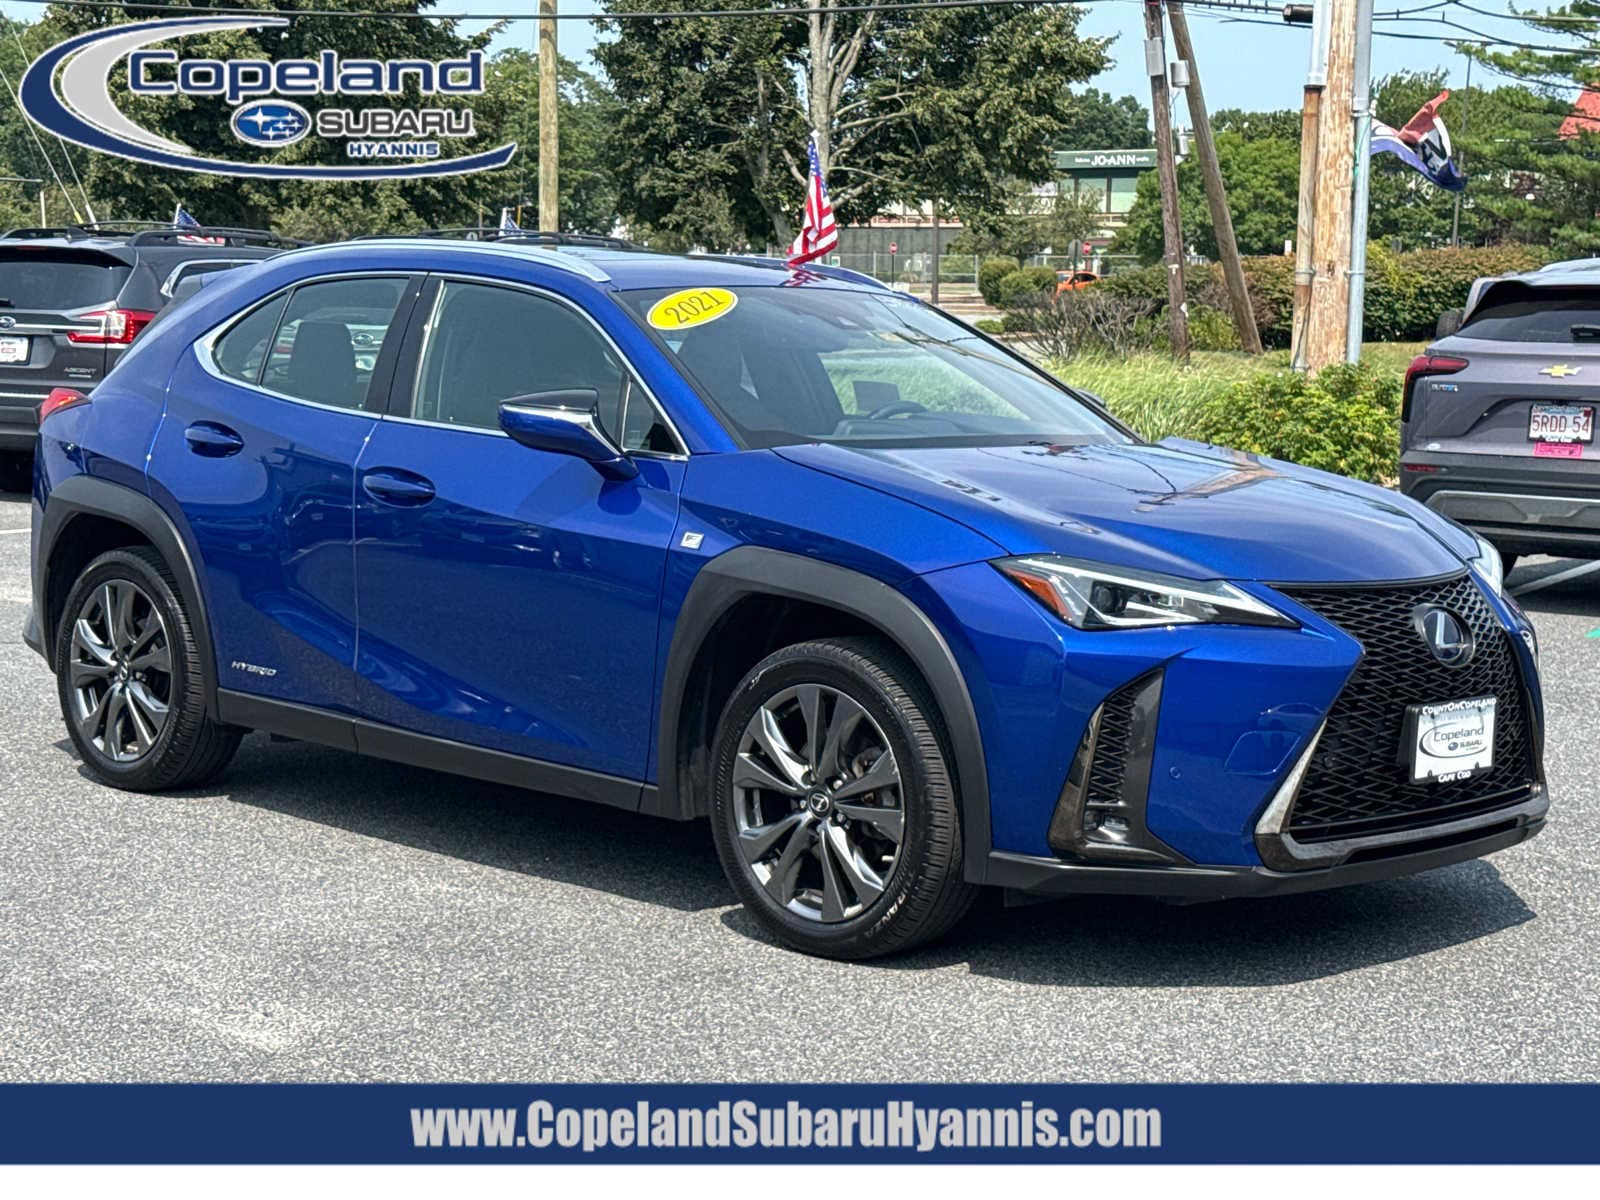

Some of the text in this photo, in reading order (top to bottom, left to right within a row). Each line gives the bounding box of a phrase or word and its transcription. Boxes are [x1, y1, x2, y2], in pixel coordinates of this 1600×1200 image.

[664, 291, 726, 324] 2021
[231, 660, 278, 677] HYBRID
[1434, 728, 1484, 742] Copeland
